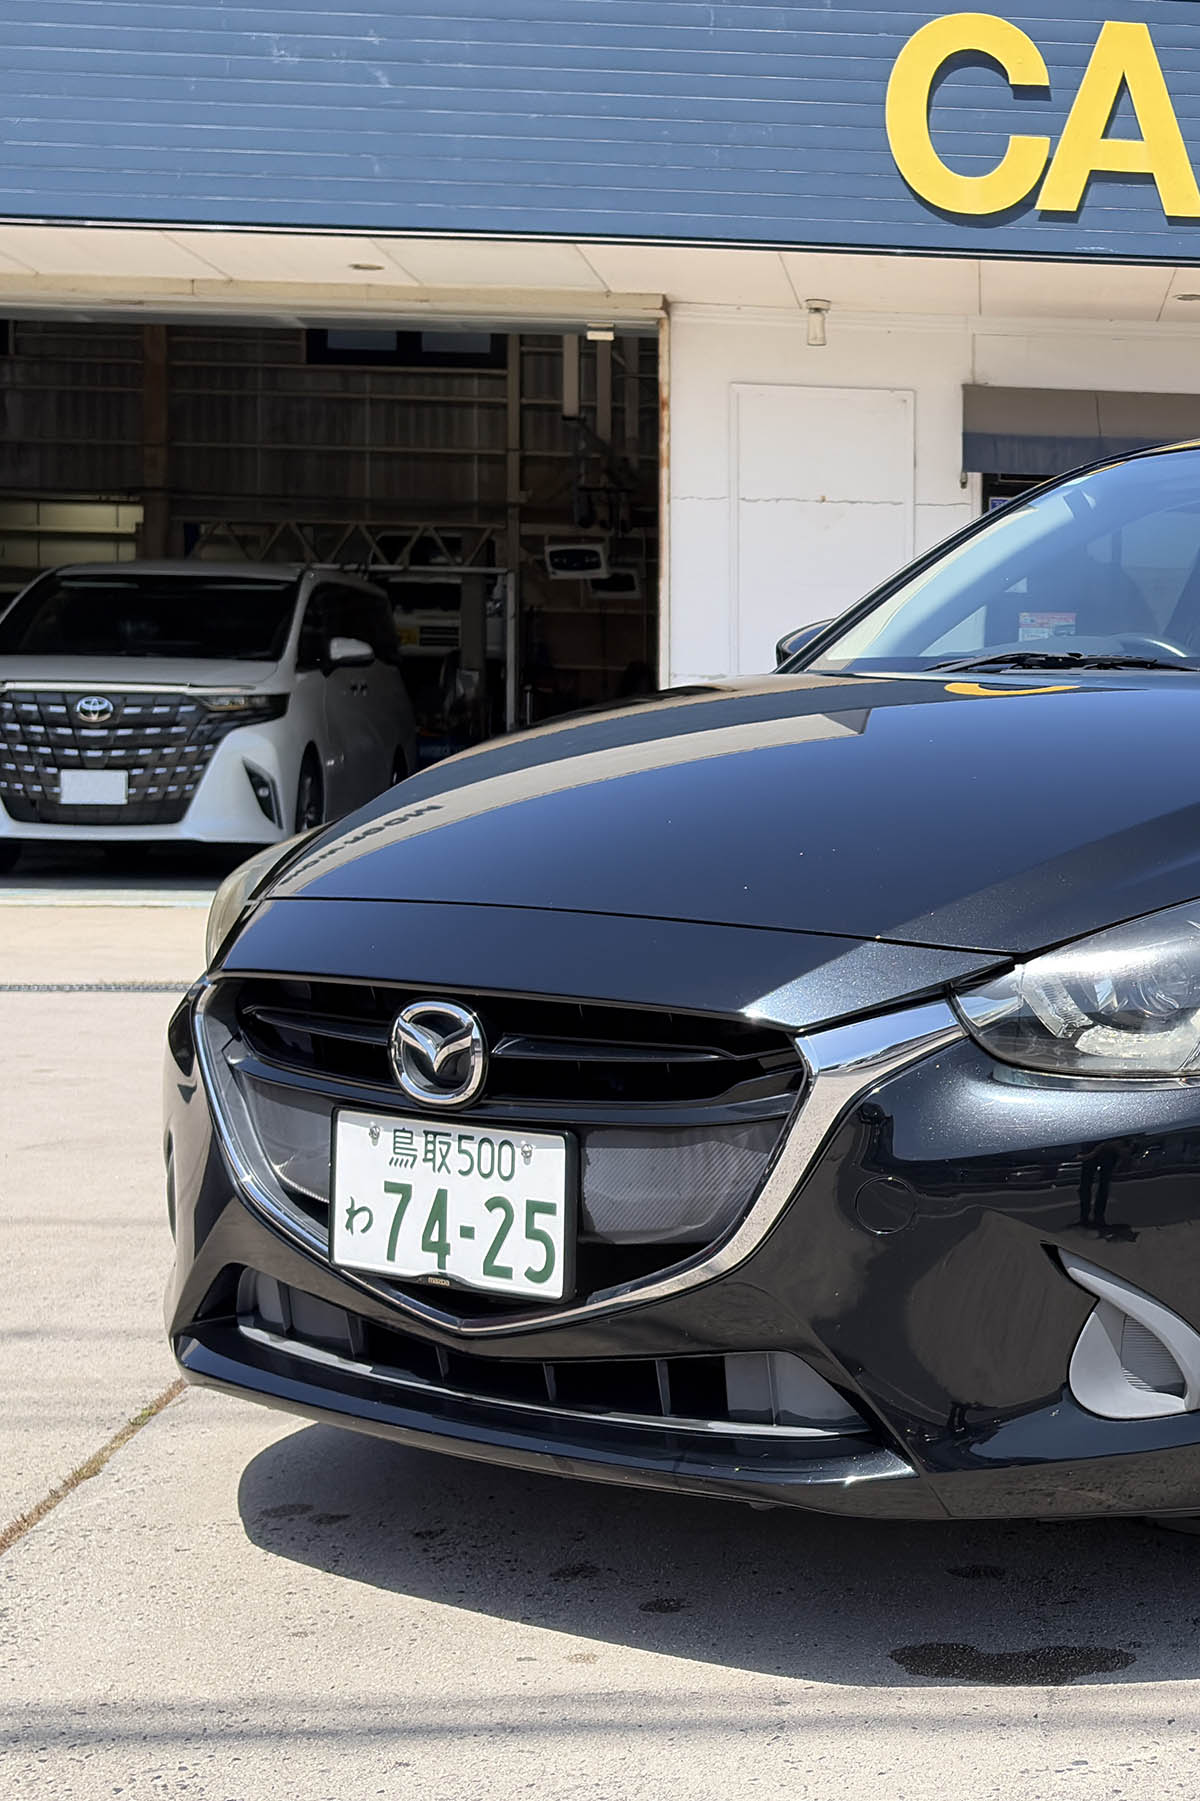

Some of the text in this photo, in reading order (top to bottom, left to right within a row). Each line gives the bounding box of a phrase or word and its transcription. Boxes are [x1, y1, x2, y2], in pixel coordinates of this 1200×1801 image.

[389, 1128, 515, 1181] 鳥取500
[345, 1181, 557, 1283] わ 74-25
